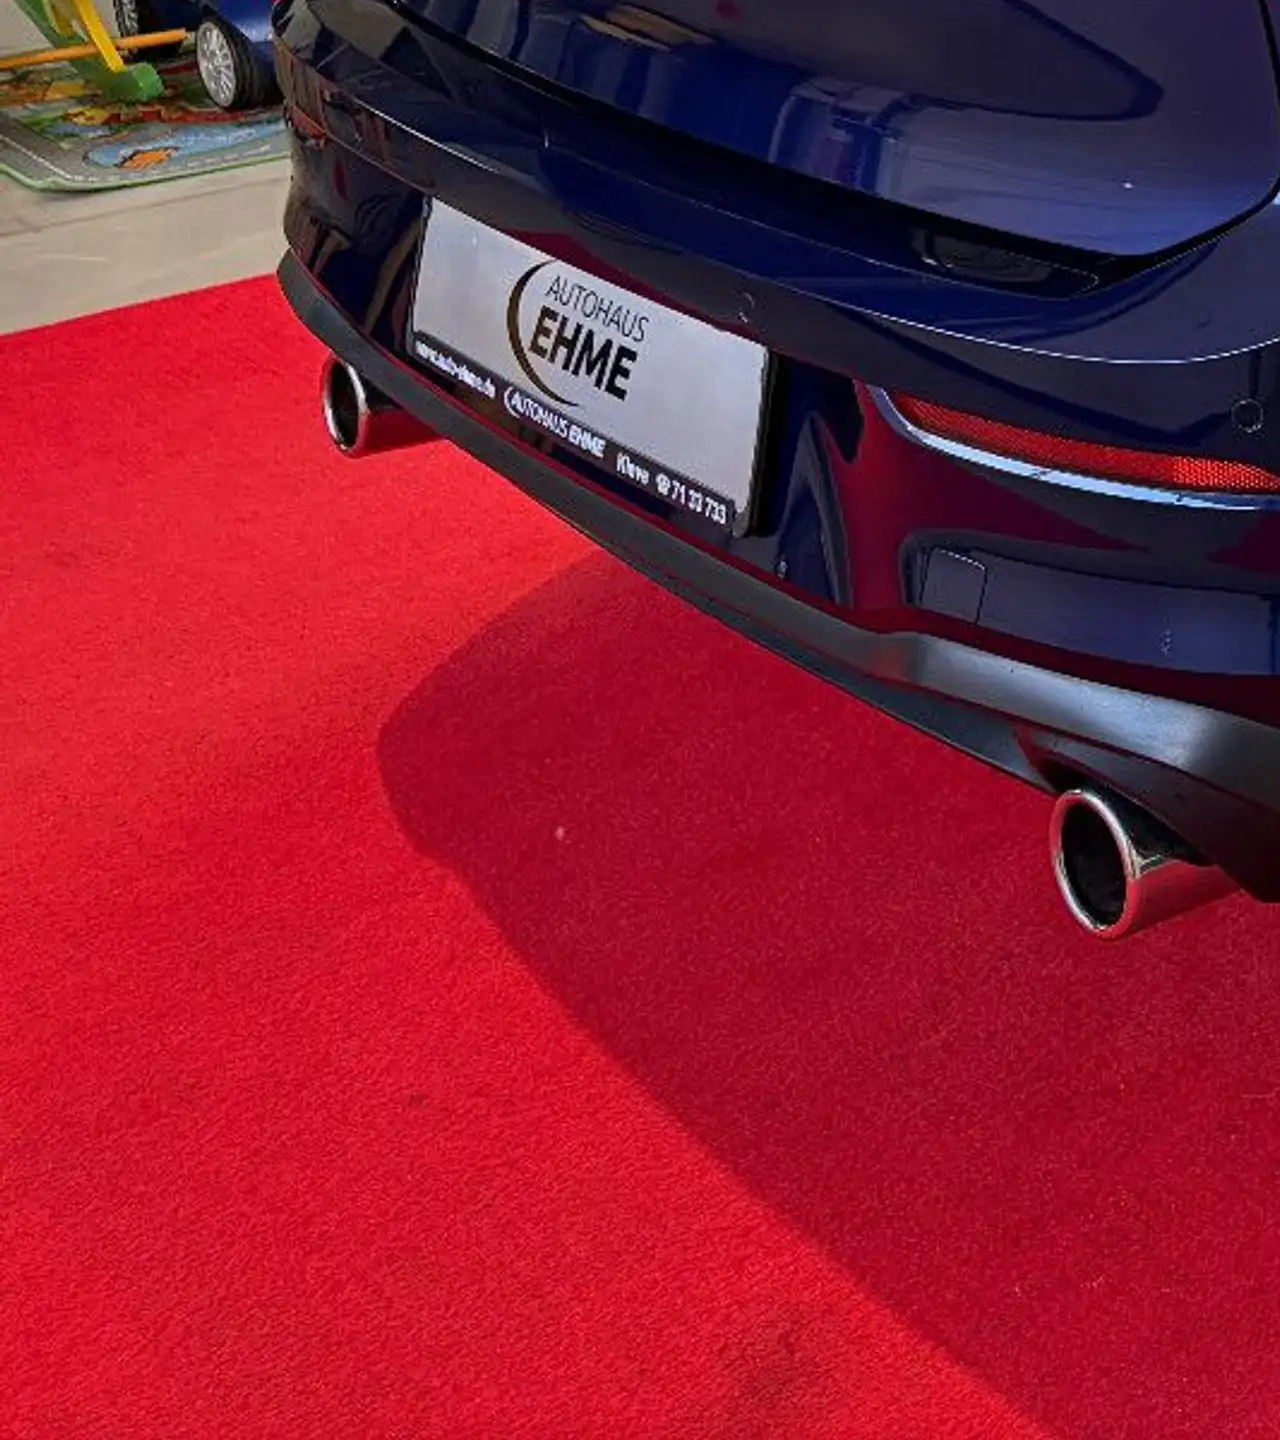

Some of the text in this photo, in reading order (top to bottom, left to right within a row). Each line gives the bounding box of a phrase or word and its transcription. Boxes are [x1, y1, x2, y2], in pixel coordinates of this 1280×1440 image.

[546, 275, 649, 343] AUTOHAUS
[529, 305, 638, 401] EHME
[510, 394, 569, 439] AUTOHAUS
[568, 424, 607, 459] EHME
